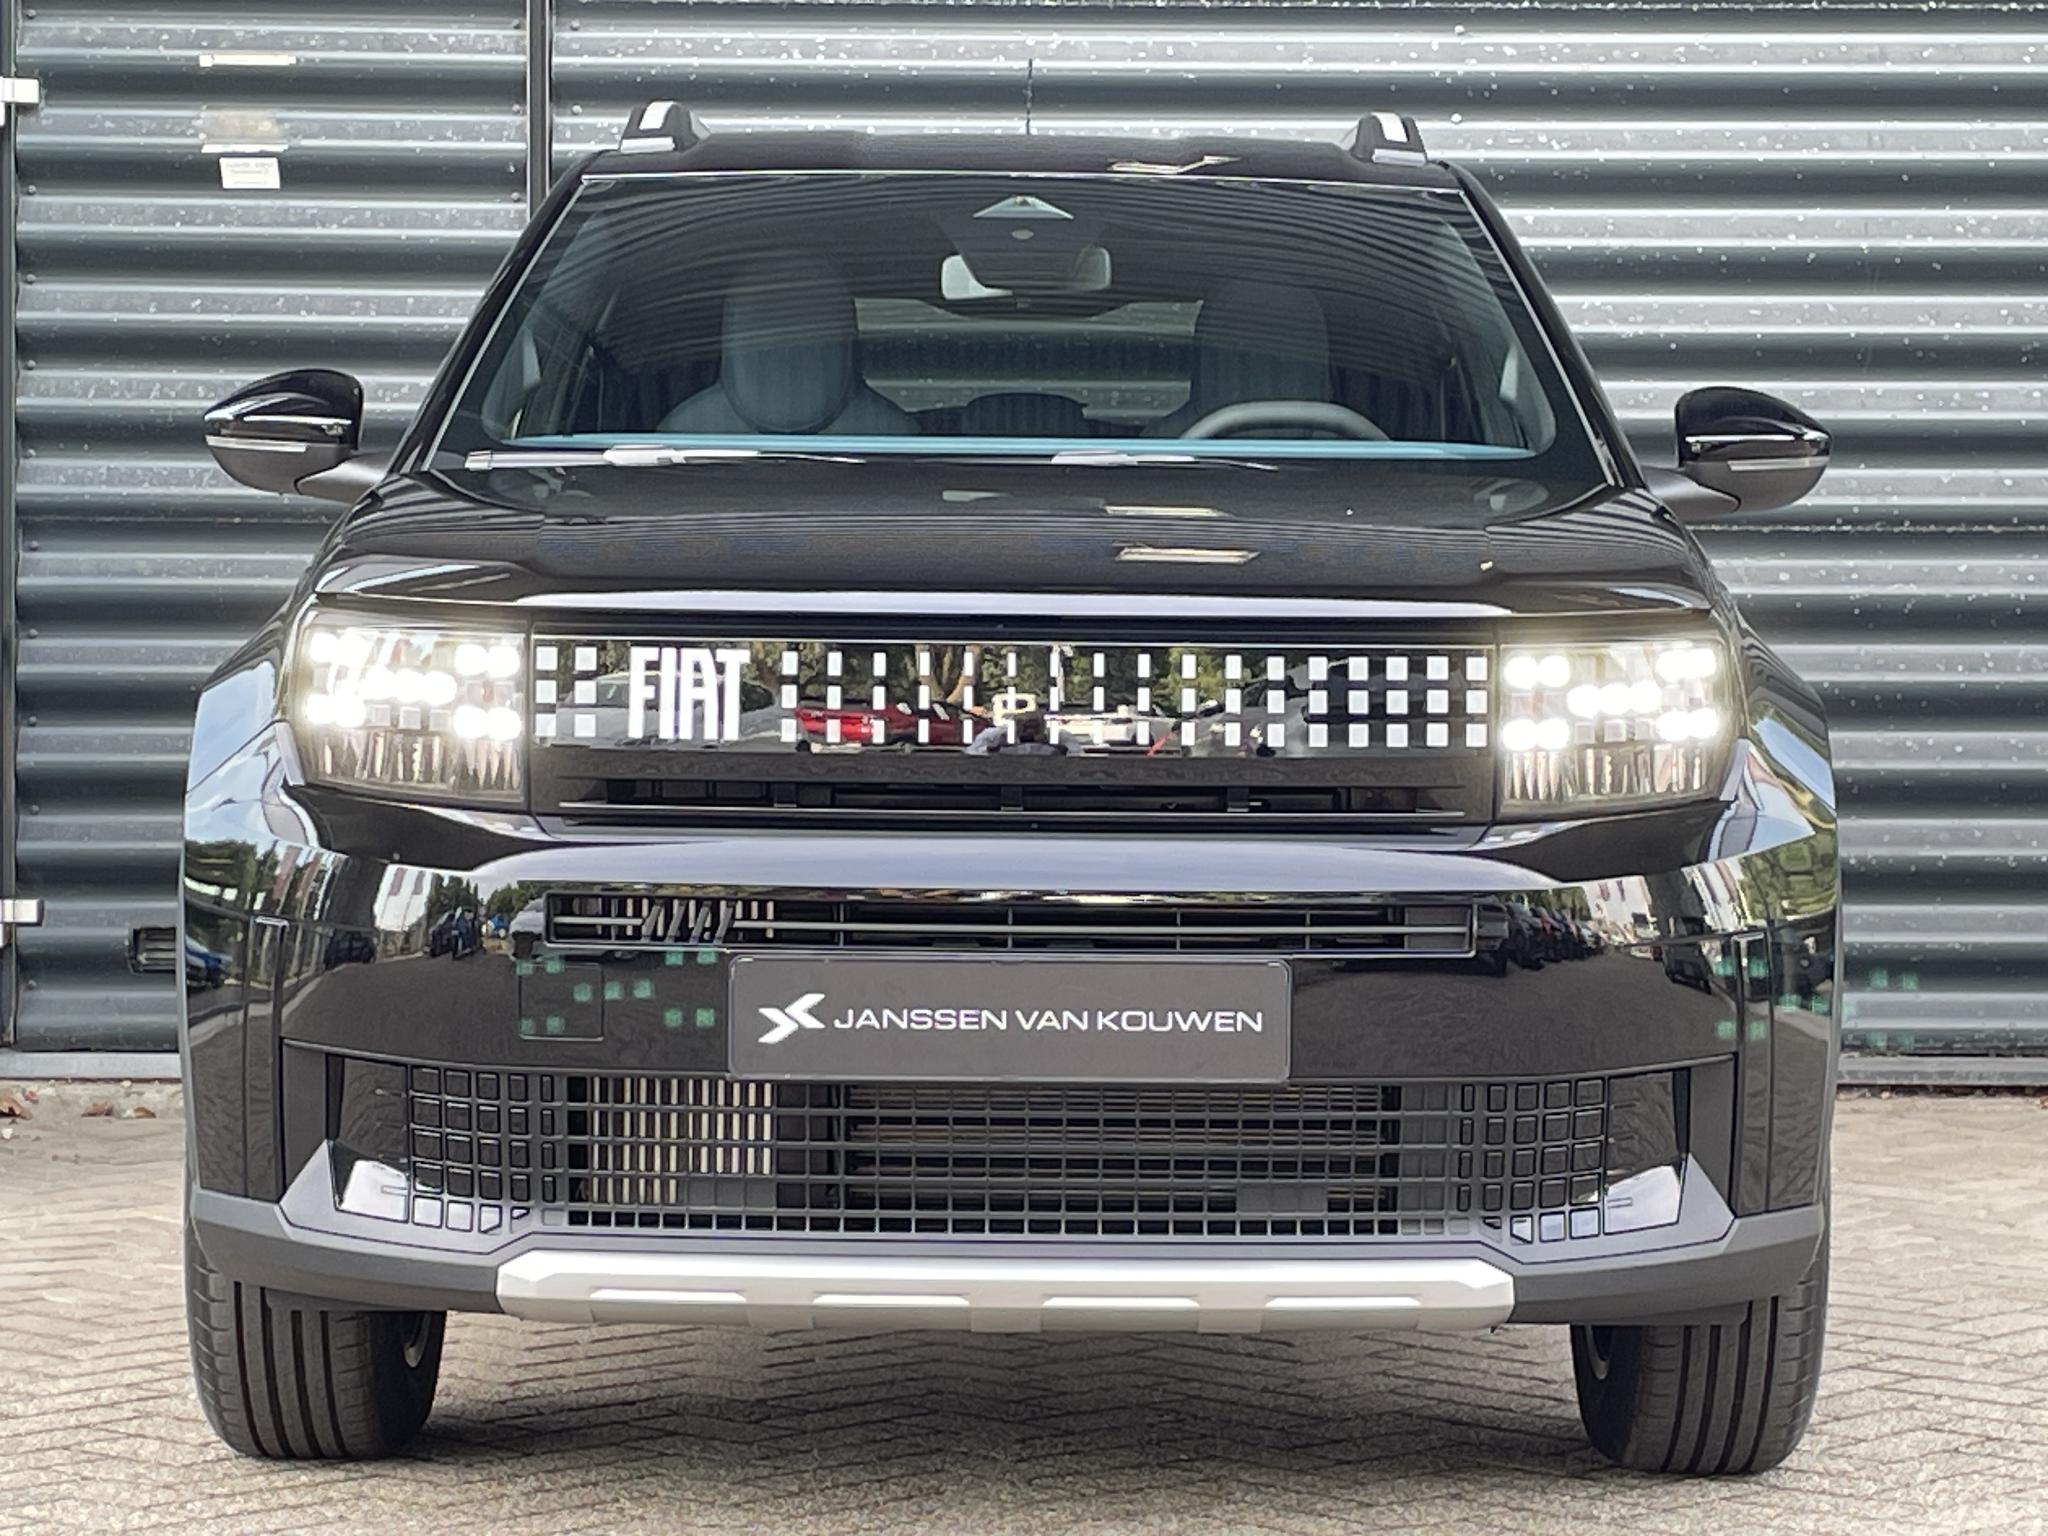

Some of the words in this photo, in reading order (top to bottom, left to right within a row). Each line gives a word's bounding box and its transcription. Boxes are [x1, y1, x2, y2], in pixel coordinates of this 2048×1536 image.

[627, 646, 751, 743] FIAT
[833, 1007, 1007, 1031] JANSSEN
[1014, 1009, 1089, 1032] VAN
[1096, 1010, 1263, 1033] KOUWEN
